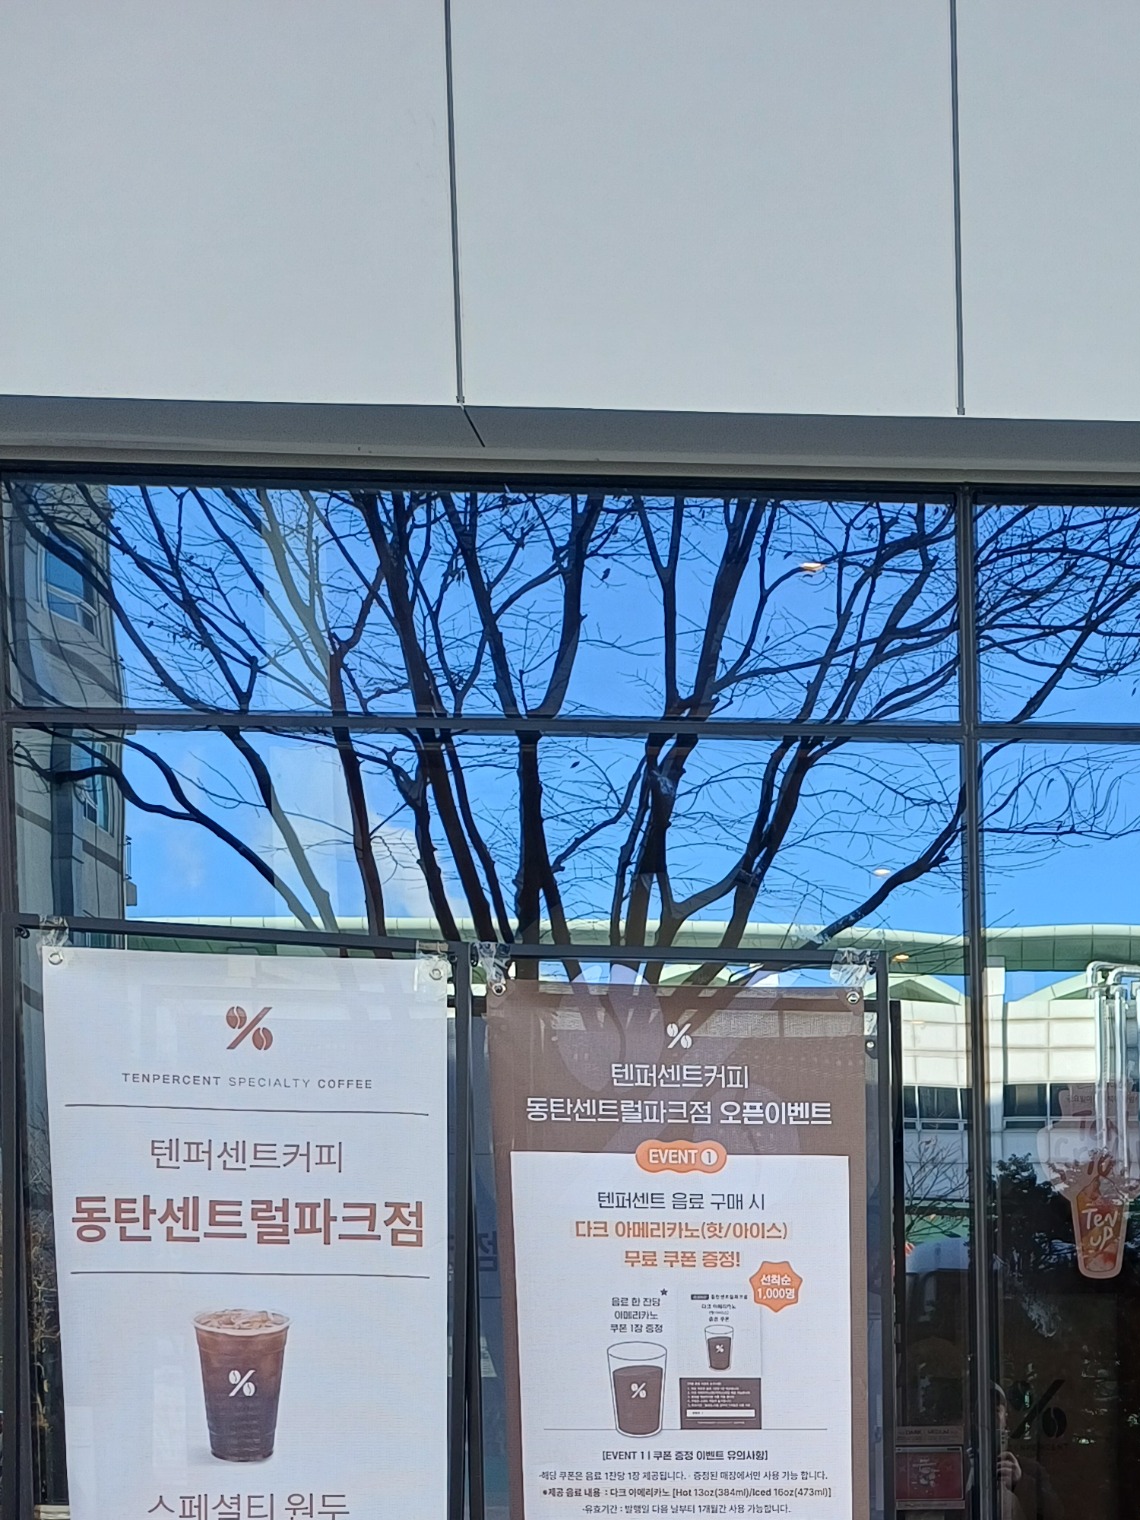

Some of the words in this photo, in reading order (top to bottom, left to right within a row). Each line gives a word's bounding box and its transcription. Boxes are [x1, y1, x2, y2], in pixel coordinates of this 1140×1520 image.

[122, 1073, 220, 1086] TENPERCENT
[229, 1076, 310, 1088] SPECIALTY
[318, 1079, 372, 1089] COFFEE
[611, 1062, 749, 1089] 텐퍼센트커피
[526, 1098, 711, 1124] 동탄센트럴파크점
[720, 1102, 832, 1125] 오픈이벤트
[151, 1138, 342, 1172] 텐퍼센트커피
[649, 1149, 697, 1165] EVENT
[598, 1191, 665, 1210] 텐퍼센트
[672, 1192, 704, 1210] 음료
[710, 1192, 743, 1210] 구매
[749, 1193, 764, 1210] 시
[71, 1195, 423, 1247] 동탄센트럴파크점
[575, 1220, 608, 1238] 다크
[615, 1221, 788, 1240] 아메리카노(핫/아이스)
[624, 1251, 657, 1268] 무료
[663, 1251, 696, 1268] 쿠폰
[702, 1251, 740, 1268] 증정!
[761, 1274, 792, 1286] 선착순
[757, 1288, 794, 1300] 1,000명
[614, 1311, 658, 1320] 아메리카노
[602, 1451, 637, 1461] [EVENT
[653, 1451, 672, 1460] 쿠폰
[675, 1451, 693, 1460] 증정
[697, 1451, 724, 1460] 이벤트
[764, 1471, 779, 1481] 사용
[611, 1488, 627, 1497] 다크
[629, 1488, 671, 1497] 아메리카노
